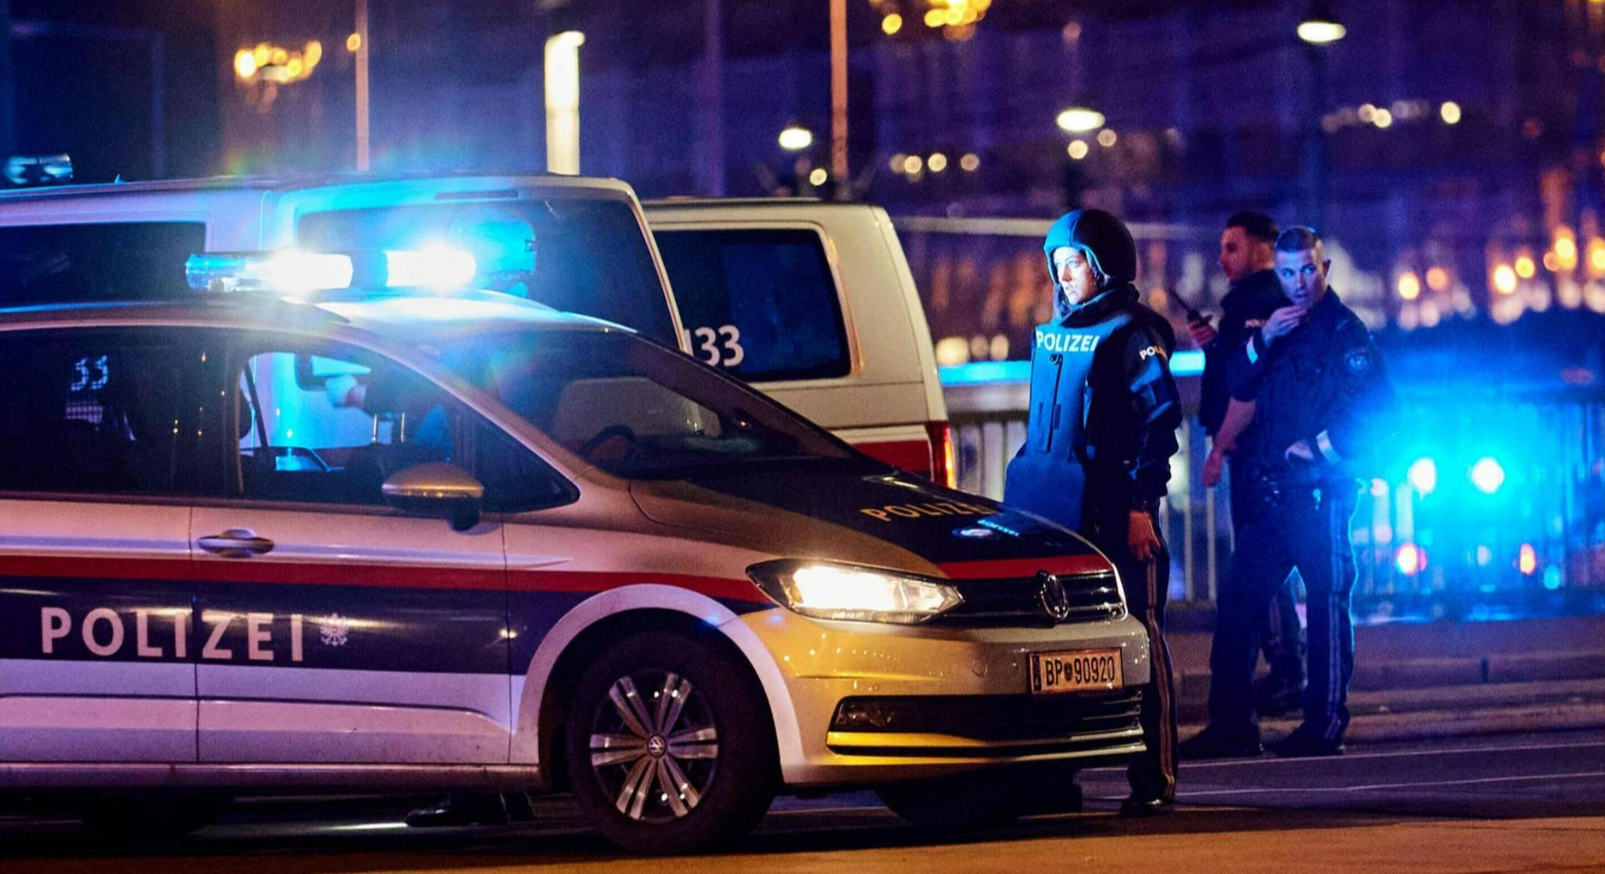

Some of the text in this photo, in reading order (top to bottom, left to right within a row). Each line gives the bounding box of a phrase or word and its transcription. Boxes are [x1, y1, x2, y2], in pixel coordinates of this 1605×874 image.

[1035, 330, 1100, 352] POLIZEI
[41, 606, 303, 662] POLIZEI
[1045, 656, 1115, 686] BP 90920
